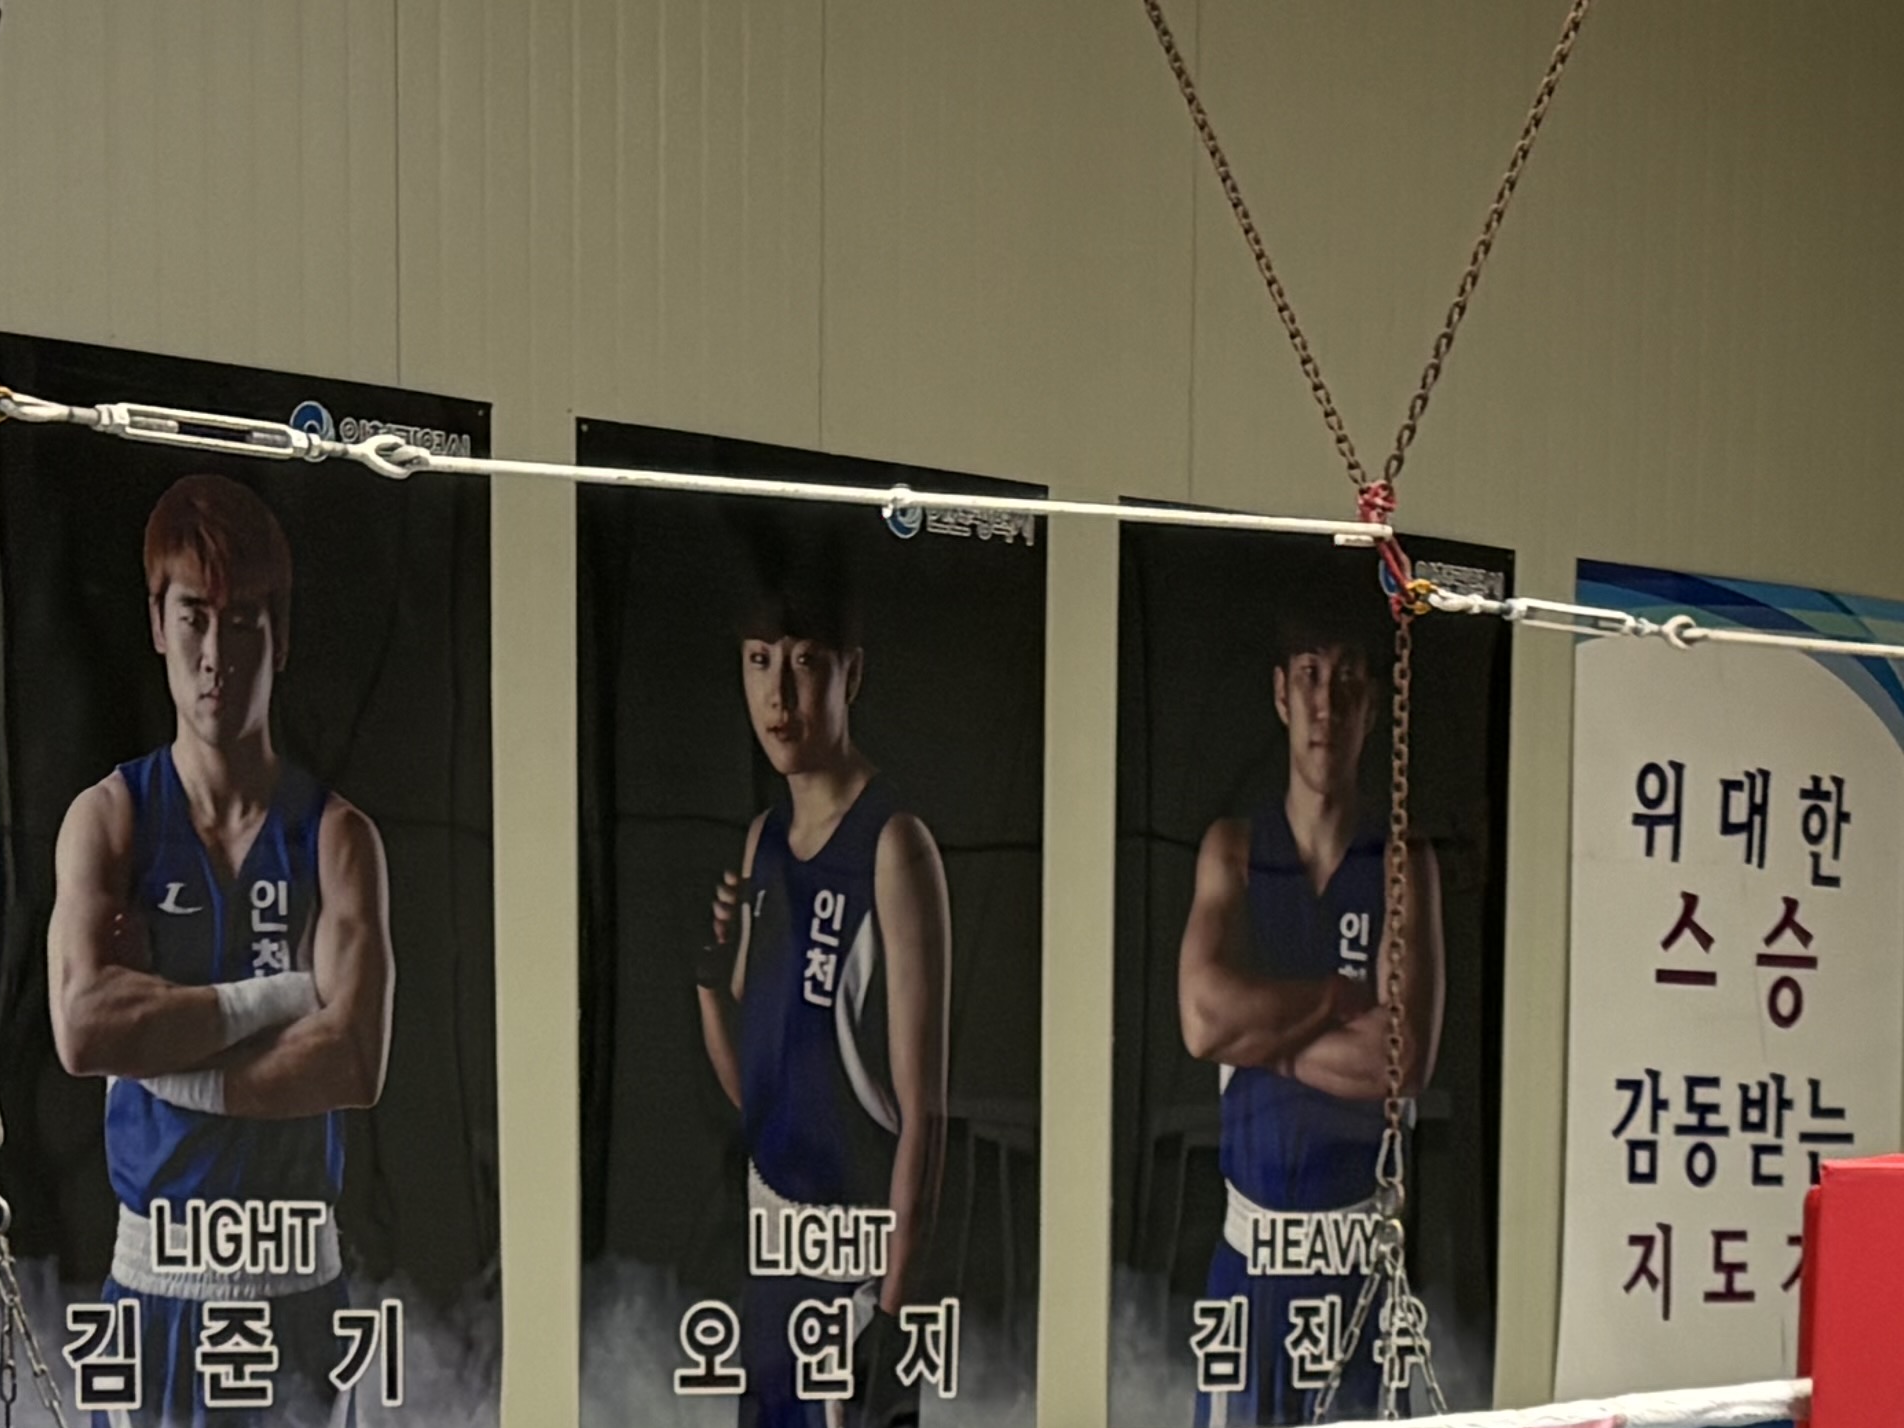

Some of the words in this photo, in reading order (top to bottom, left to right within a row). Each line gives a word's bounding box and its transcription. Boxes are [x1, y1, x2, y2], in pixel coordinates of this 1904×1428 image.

[803, 889, 845, 1007] 인천
[149, 1198, 328, 1276] LIGHT
[747, 1207, 896, 1279] LIGHT
[1246, 1209, 1384, 1278] HEAVY
